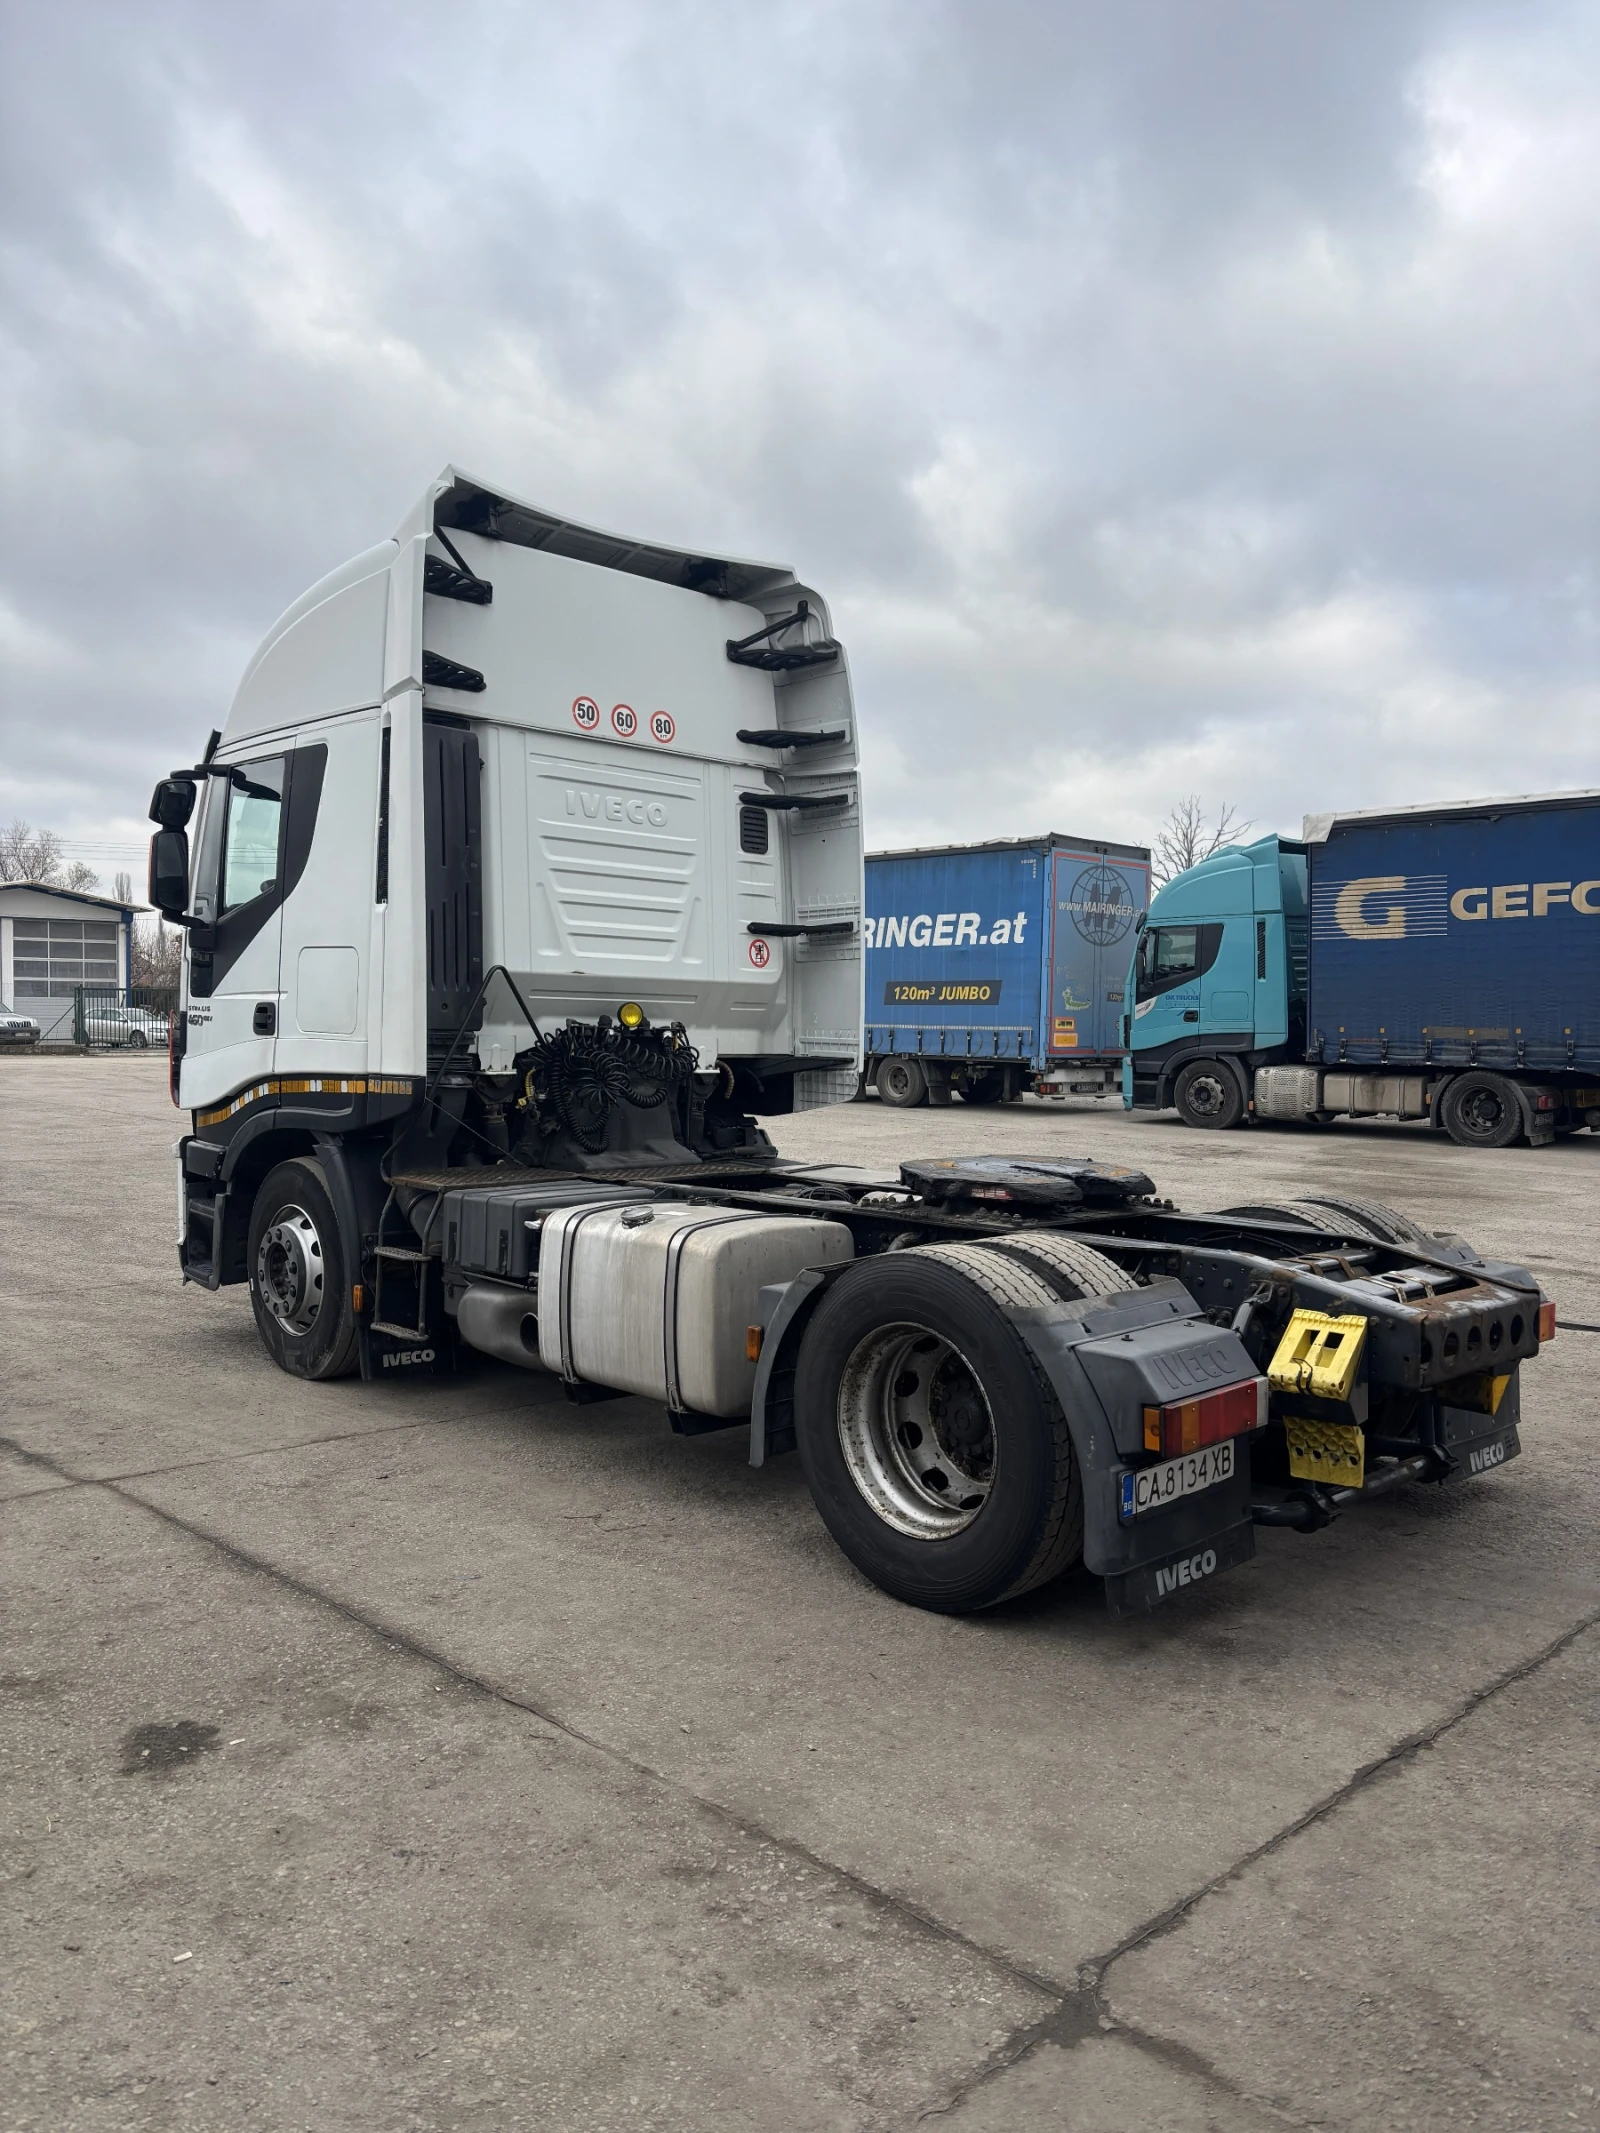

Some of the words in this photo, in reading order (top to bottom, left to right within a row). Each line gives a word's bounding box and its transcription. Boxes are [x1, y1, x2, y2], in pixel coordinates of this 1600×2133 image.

[577, 702, 596, 722] 50
[616, 711, 633, 729] 60
[655, 718, 672, 735] 80
[565, 789, 668, 828] IVECO
[864, 911, 1028, 949] RINGER.at
[938, 985, 991, 1001] JUMBO
[382, 1348, 436, 1368] IVECO
[1152, 1340, 1237, 1390] IVECO
[1469, 1441, 1505, 1473] IVECO
[1165, 1453, 1209, 1496] 8134
[1211, 1445, 1232, 1481] XB
[1123, 1500, 1133, 1512] BG
[1155, 1549, 1217, 1597] IVECO
